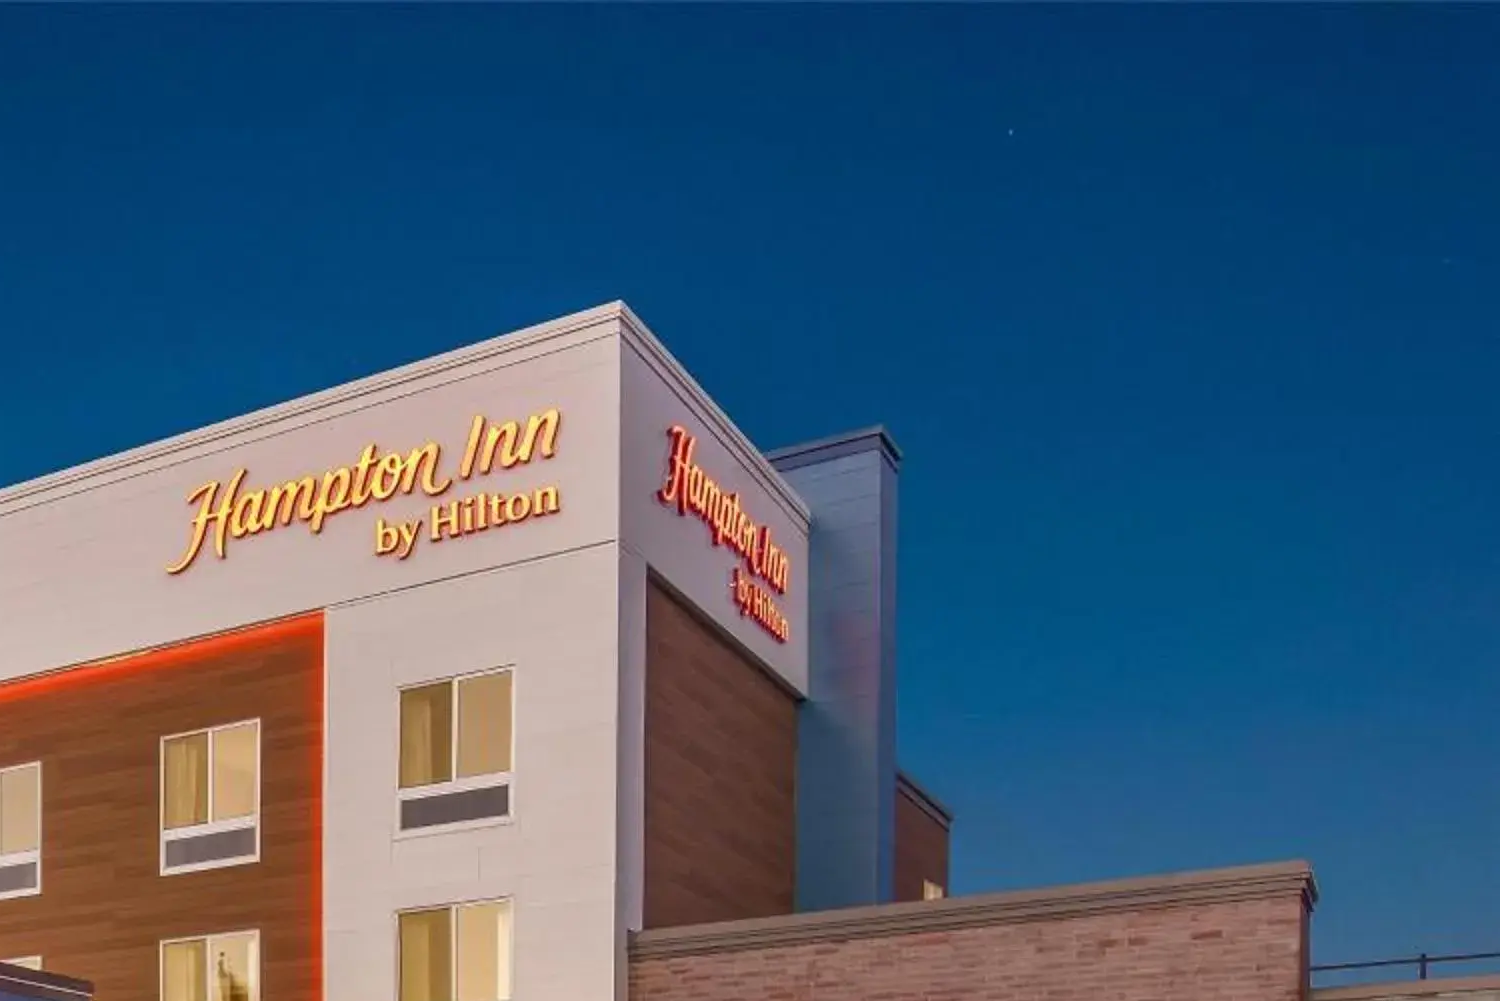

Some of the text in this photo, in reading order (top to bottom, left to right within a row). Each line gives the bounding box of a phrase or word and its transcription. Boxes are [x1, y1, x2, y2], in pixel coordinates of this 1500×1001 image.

[166, 408, 561, 575] Hampton Inn
[375, 485, 560, 560] by Hilton
[657, 424, 789, 595] Hampton Inn
[733, 568, 789, 643] by Hilton
